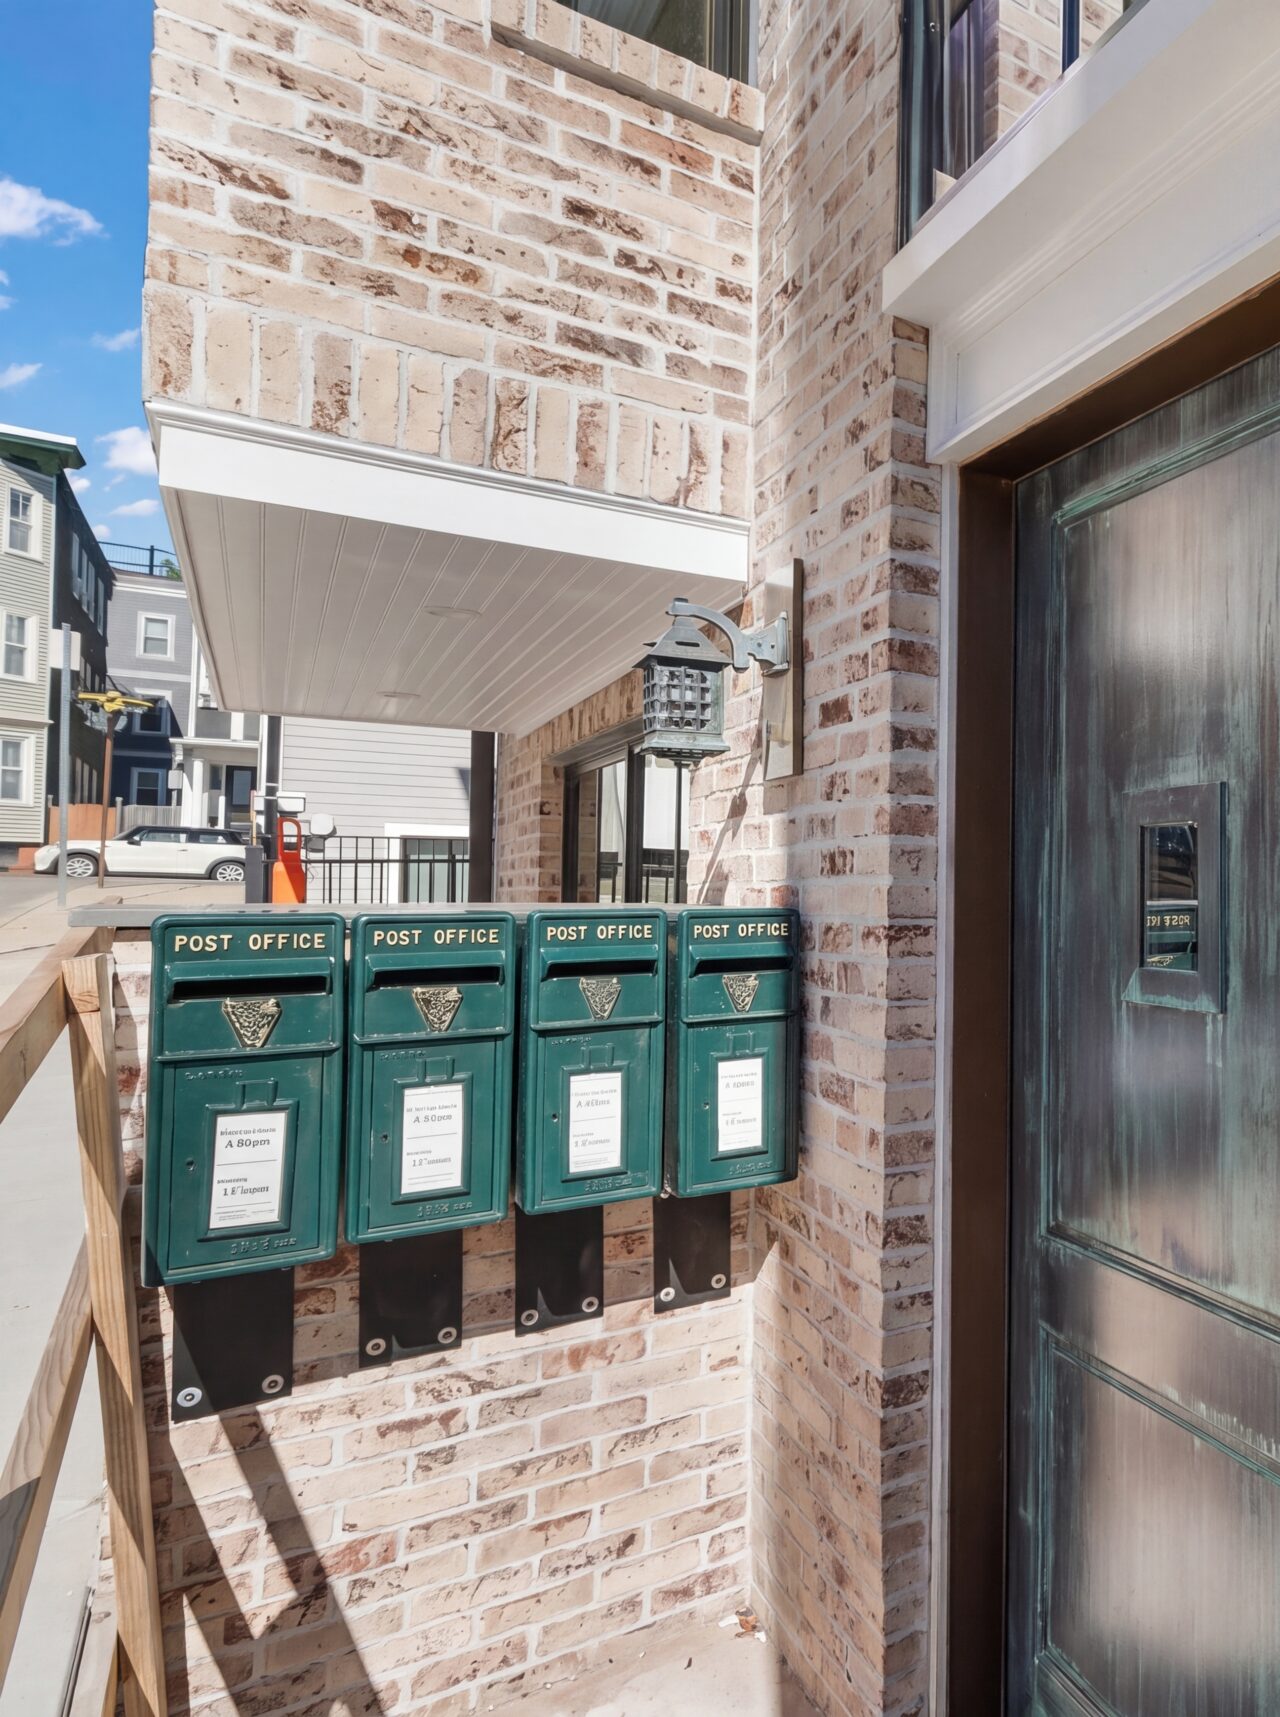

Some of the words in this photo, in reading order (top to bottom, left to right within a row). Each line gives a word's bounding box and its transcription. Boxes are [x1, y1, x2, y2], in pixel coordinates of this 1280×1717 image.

[373, 930, 422, 946] POST
[434, 928, 500, 944] OFFICE
[547, 925, 588, 941] POST
[597, 924, 653, 939] OFFICE
[693, 924, 730, 939] POST
[738, 922, 789, 937] OFFICE
[173, 934, 233, 952] POST
[248, 933, 327, 950] OFFICE
